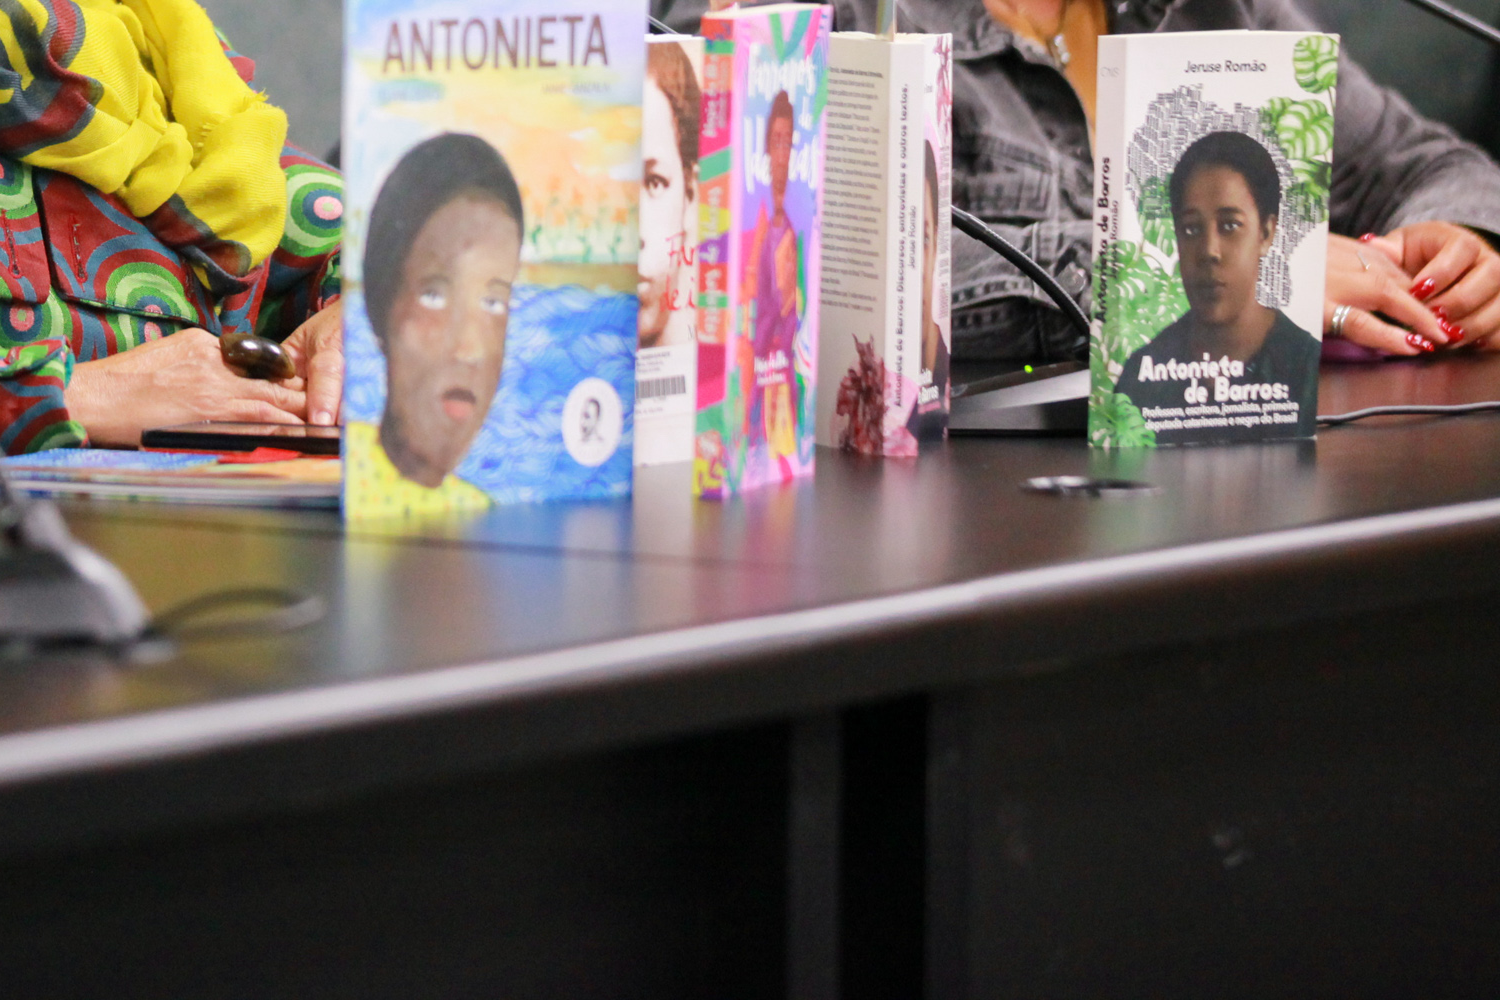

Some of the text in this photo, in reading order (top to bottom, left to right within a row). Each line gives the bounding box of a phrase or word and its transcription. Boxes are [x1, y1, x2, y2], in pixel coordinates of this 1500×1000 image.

[381, 14, 610, 74] ANTONIETA
[1184, 60, 1267, 73] Jeruse Romão
[900, 124, 908, 159] outros
[907, 205, 917, 269] Jeruse Romão
[1095, 157, 1110, 324] Antonieta de Barros
[1108, 200, 1119, 278] Jeruse Romão
[897, 236, 906, 292] Discursos,
[895, 296, 904, 335] Barros:
[895, 338, 903, 352] de
[894, 356, 903, 408] Antonieta
[1138, 352, 1244, 382] Antonieta
[1184, 376, 1289, 404] de Barros:
[1142, 400, 1300, 419] Professora, escritora, jornalista, primeira
[1144, 418, 1183, 432] deputada
[1183, 416, 1228, 428] catarinense
[1235, 415, 1260, 428] negra
[1260, 412, 1272, 424] do
[1273, 411, 1298, 424] Brasil
